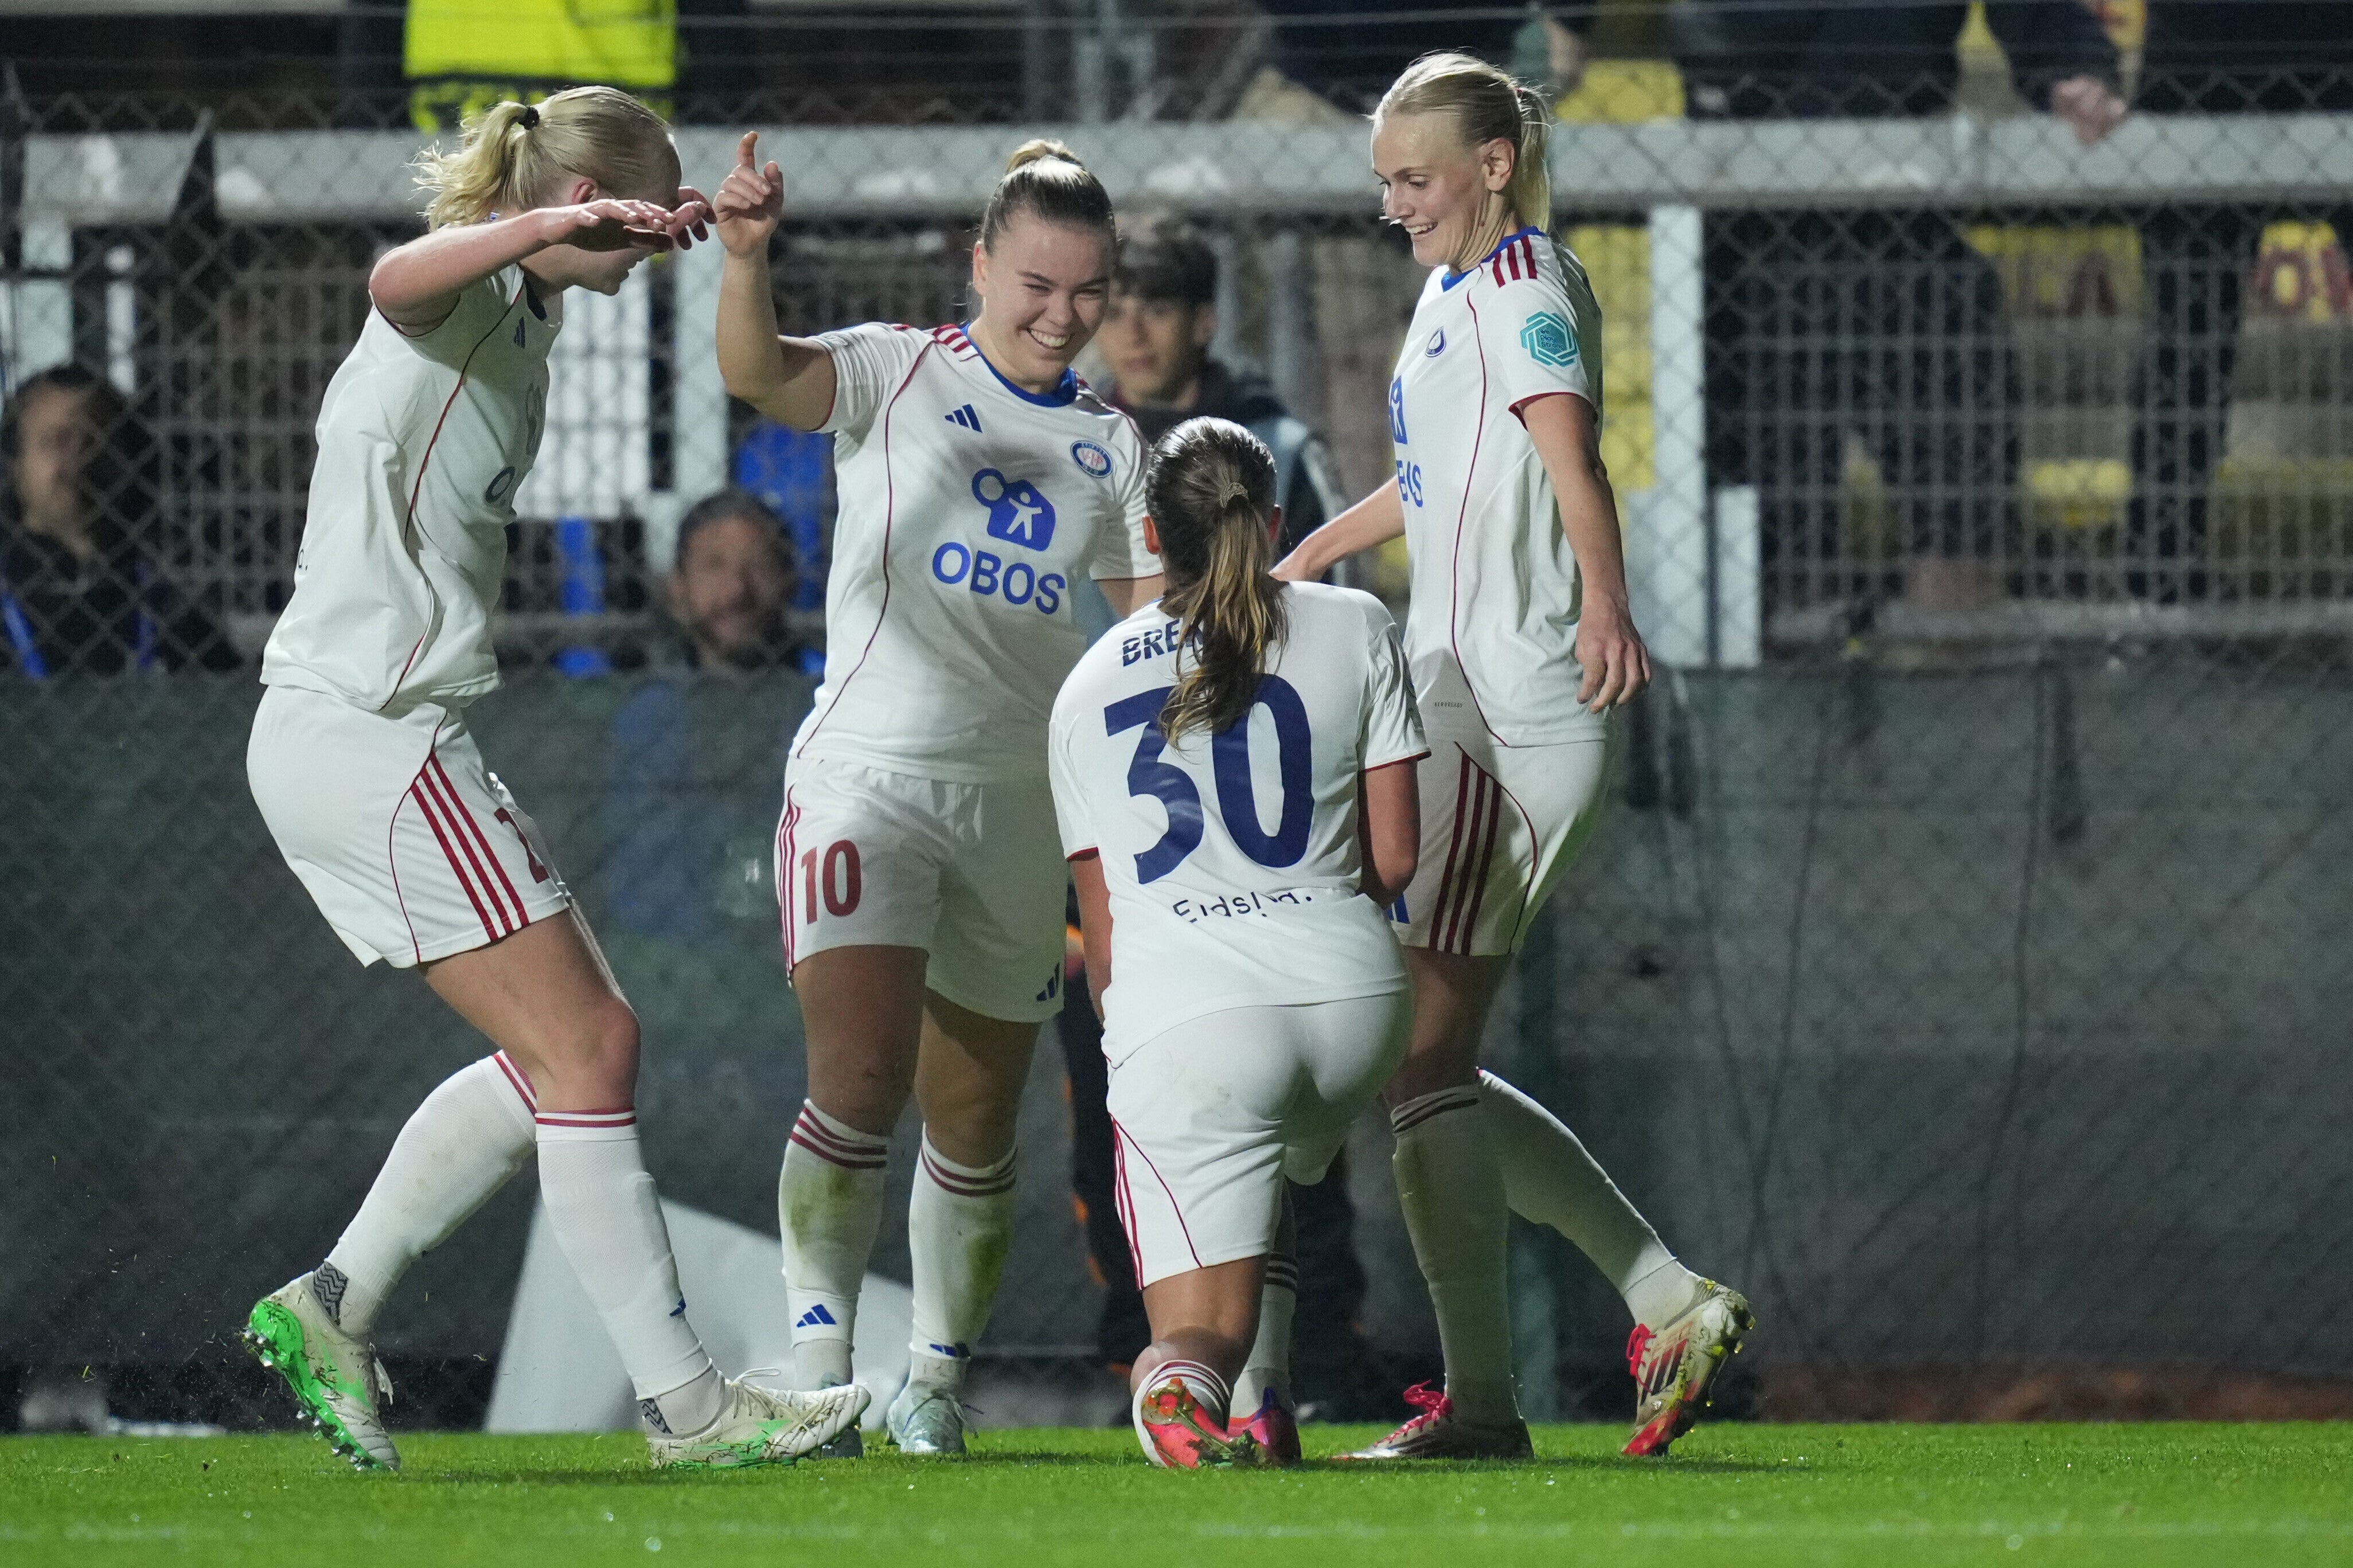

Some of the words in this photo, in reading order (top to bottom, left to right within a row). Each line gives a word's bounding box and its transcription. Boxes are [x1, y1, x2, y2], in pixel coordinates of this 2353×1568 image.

[932, 542, 1065, 615] OBOS
[1104, 673, 1314, 885] 30
[801, 840, 861, 925] 10
